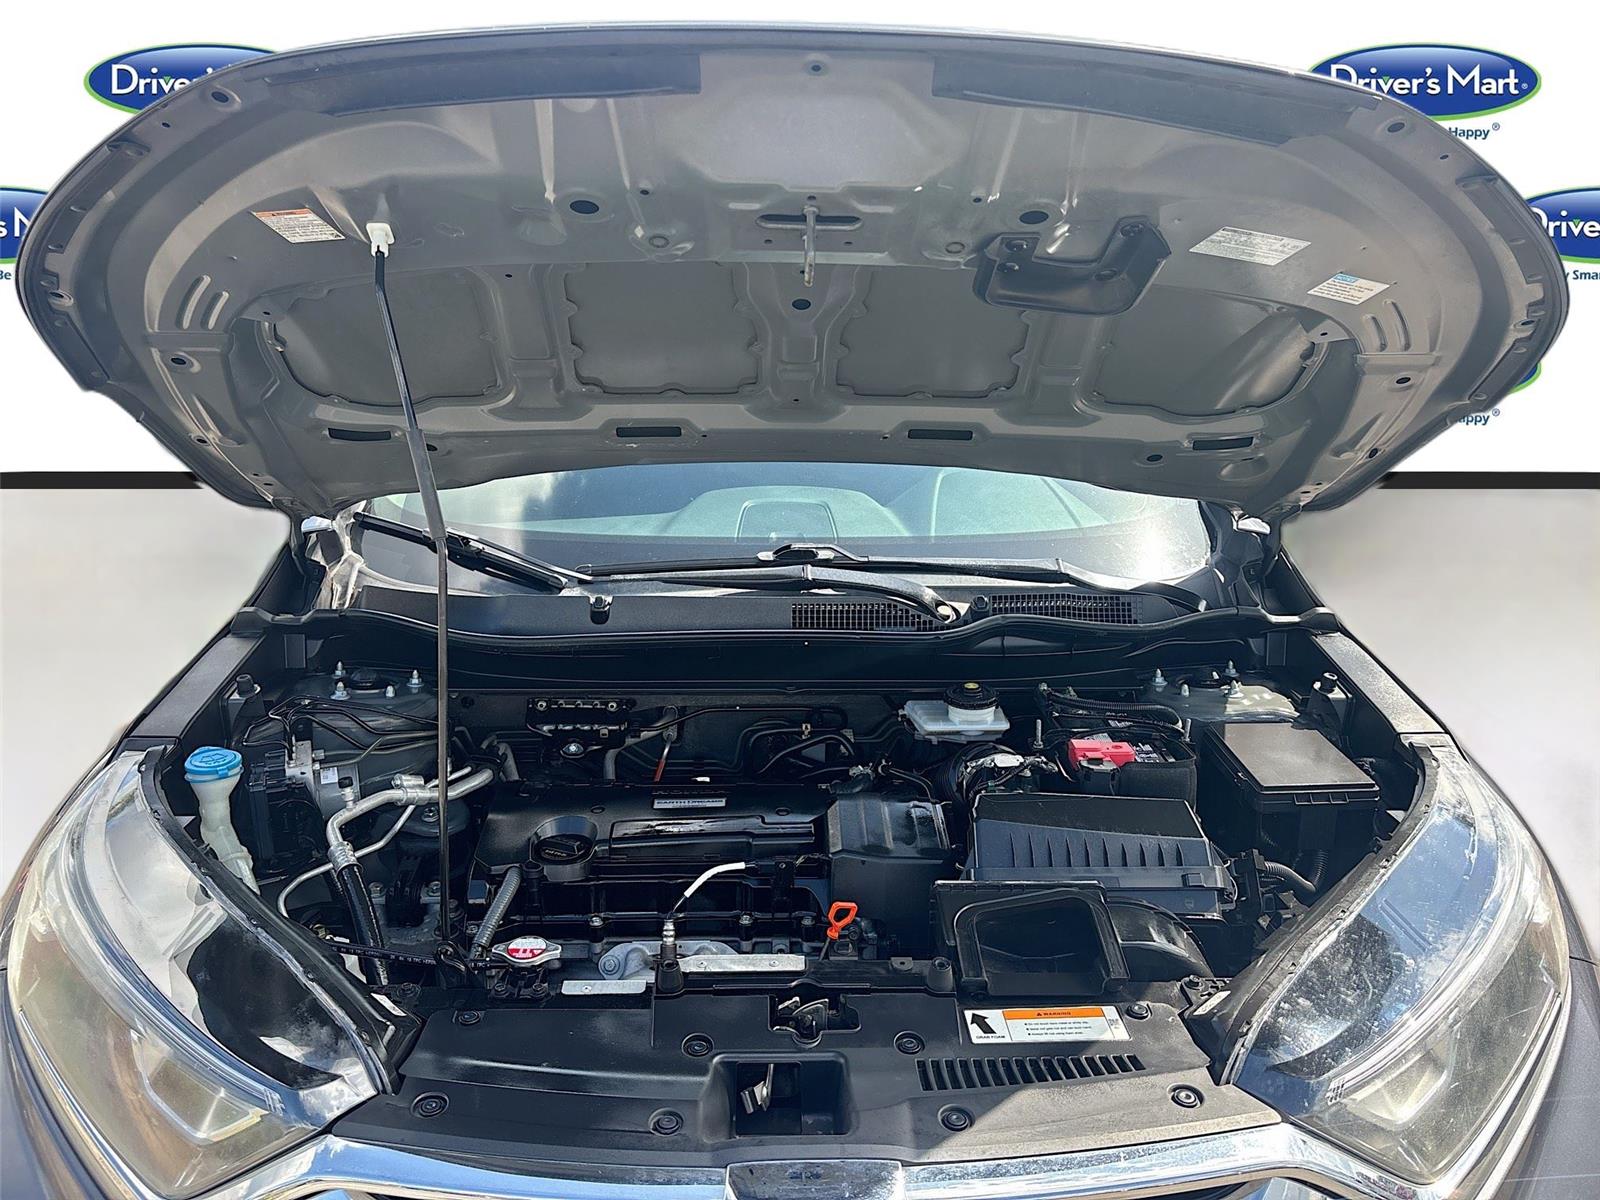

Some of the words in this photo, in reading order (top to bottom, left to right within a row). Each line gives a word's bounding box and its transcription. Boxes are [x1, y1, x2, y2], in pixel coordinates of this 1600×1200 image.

[1330, 64, 1440, 94] Driver's
[1447, 64, 1519, 95] Mart
[1456, 414, 1490, 426] appy
